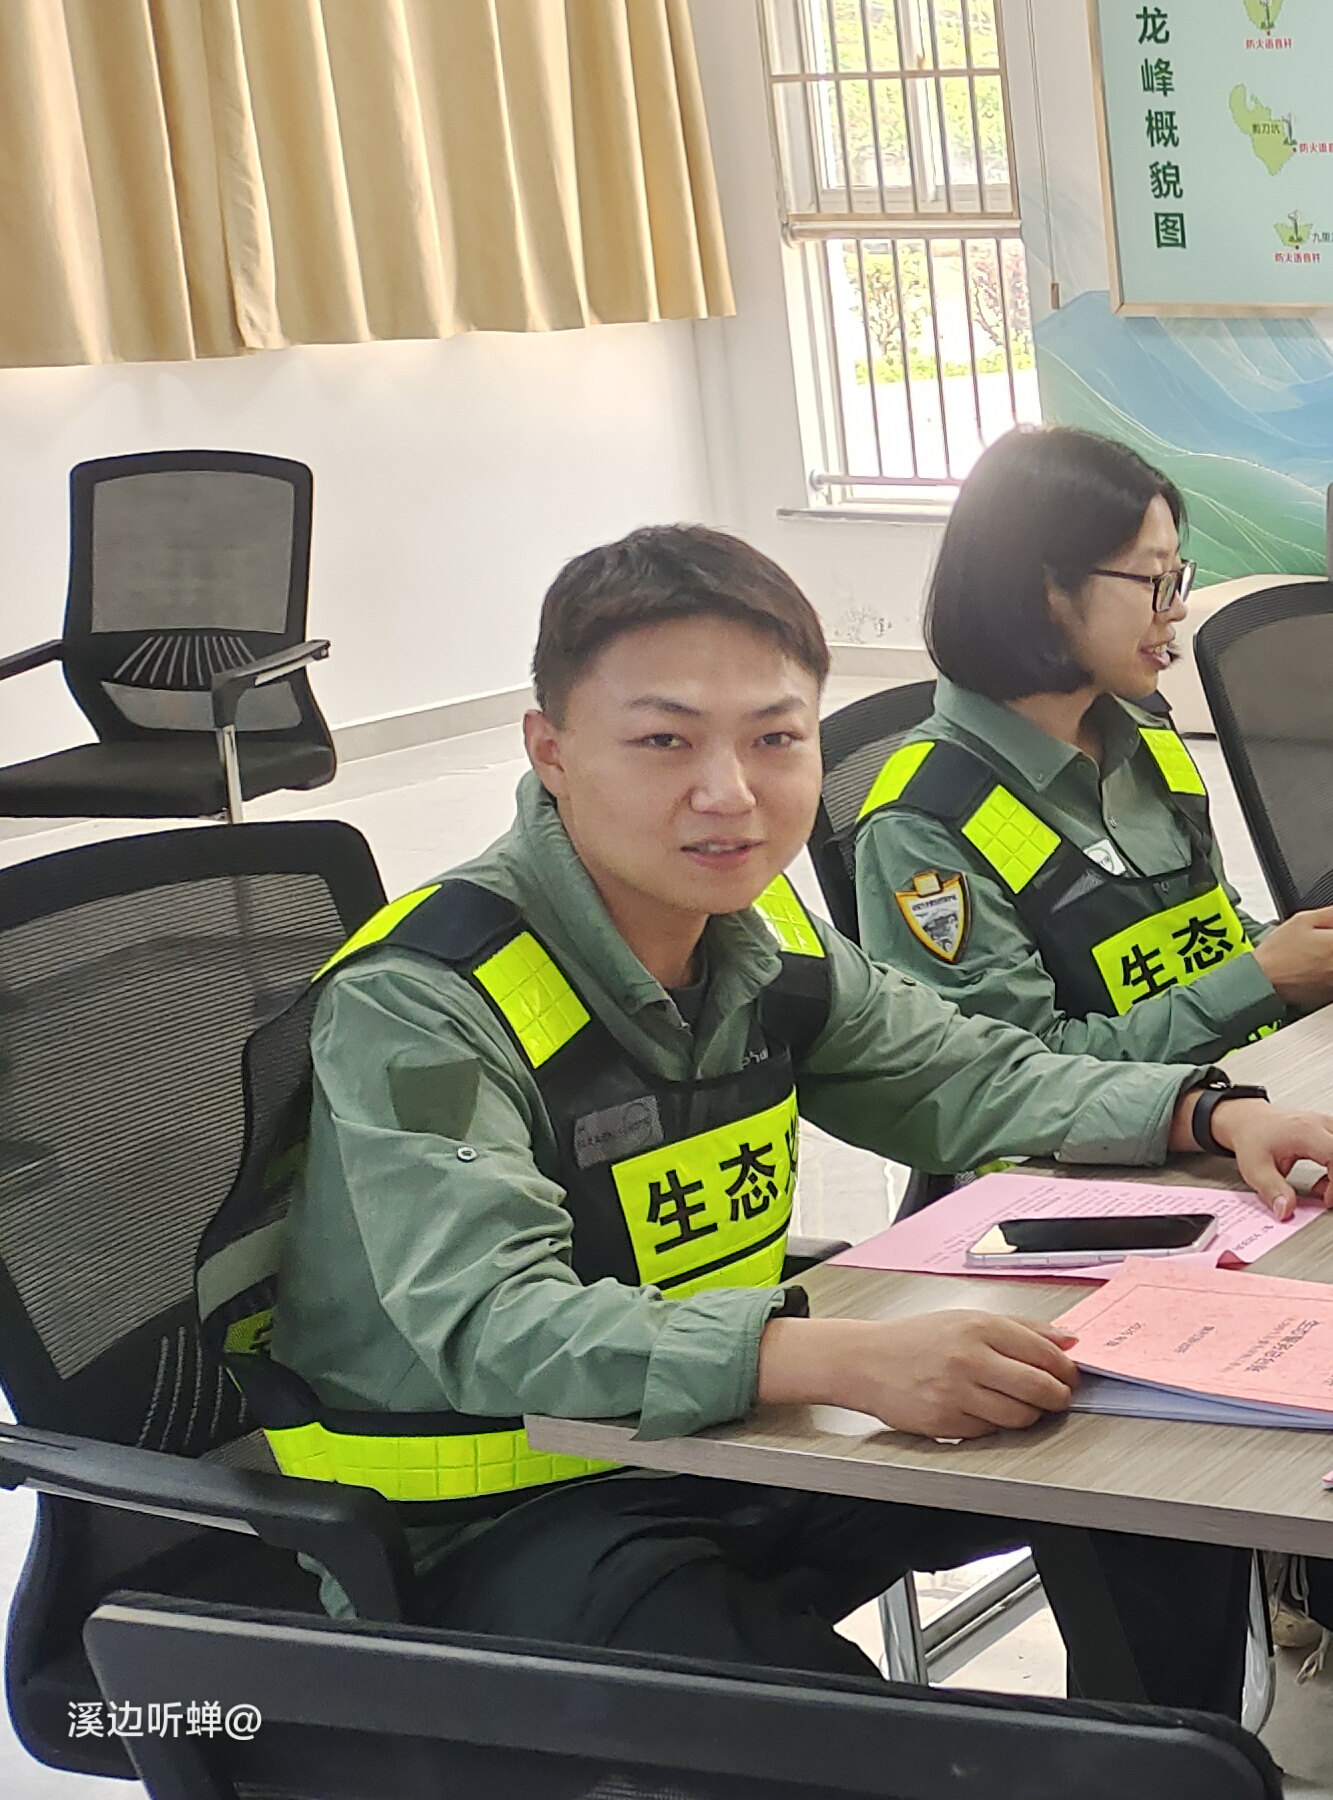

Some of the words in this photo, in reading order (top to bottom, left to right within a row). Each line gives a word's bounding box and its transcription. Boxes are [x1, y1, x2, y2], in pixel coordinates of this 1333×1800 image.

[1136, 6, 1187, 249] 龙峰概貌图
[1121, 913, 1245, 1005] 生态
